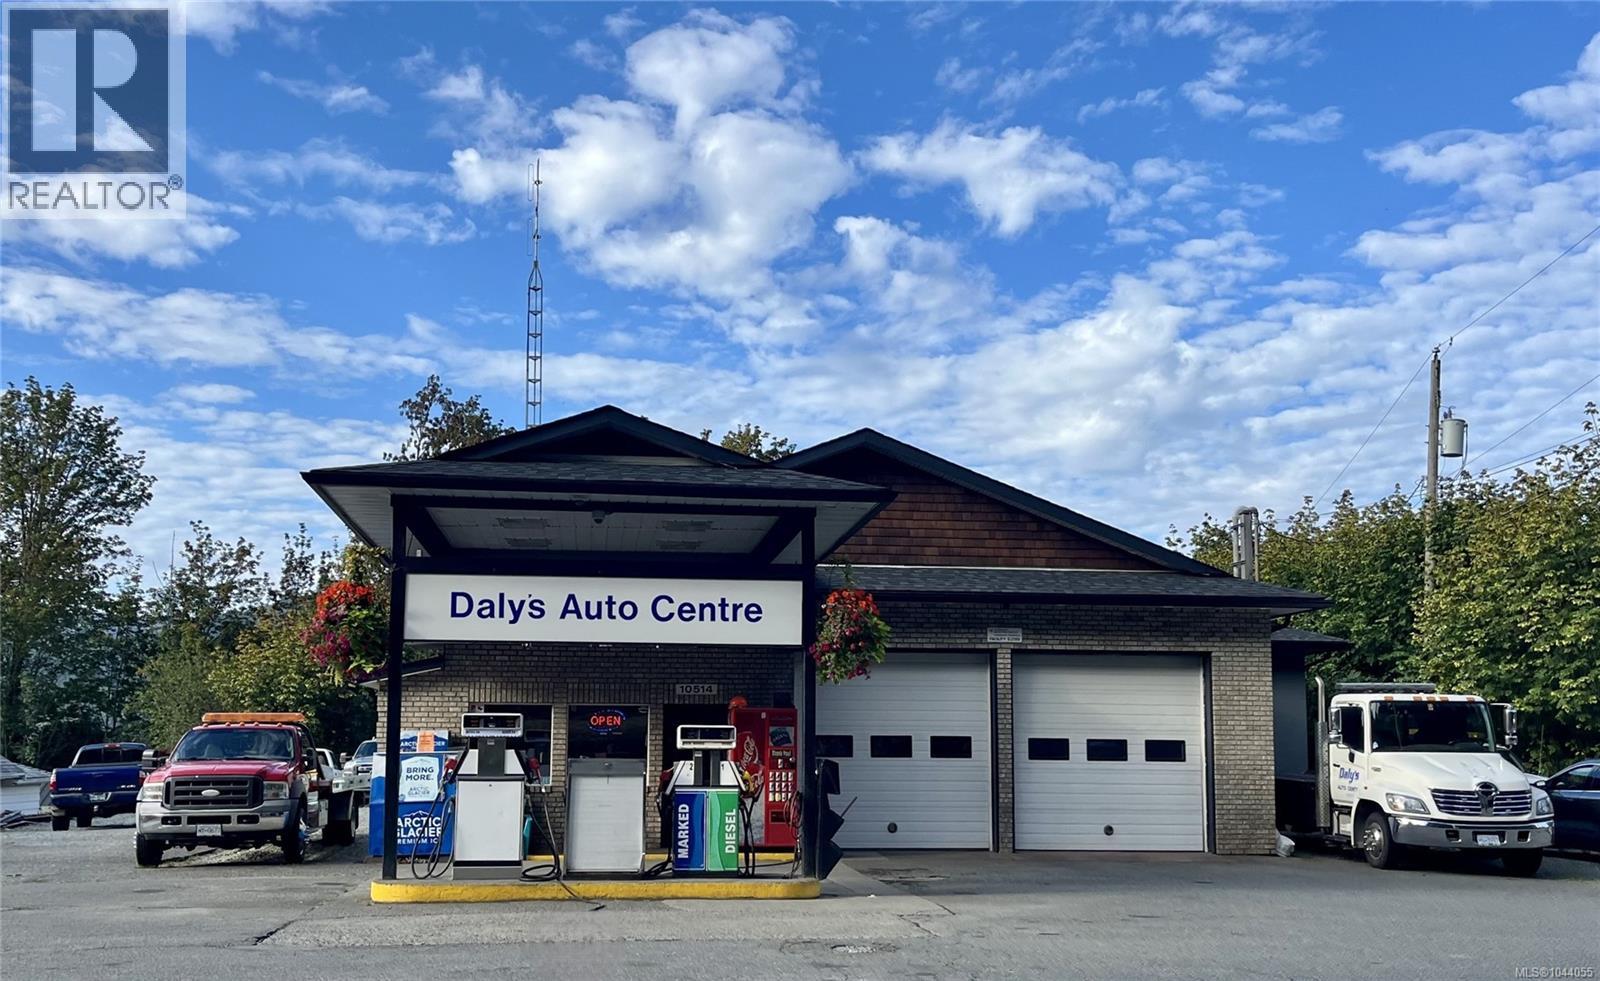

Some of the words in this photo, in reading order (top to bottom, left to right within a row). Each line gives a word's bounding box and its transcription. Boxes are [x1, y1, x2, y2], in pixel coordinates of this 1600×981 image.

[450, 591, 546, 624] Daly's
[559, 593, 639, 621] Auto
[651, 594, 764, 623] Centre
[680, 685, 713, 694] 10514
[590, 715, 621, 726] OPEN
[406, 766, 434, 774] BRING
[1339, 767, 1360, 783] Daly's
[397, 817, 441, 828] ARCTIC
[397, 827, 442, 838] LACIER
[677, 803, 690, 859] MARKED
[725, 808, 736, 854] DIESEL
